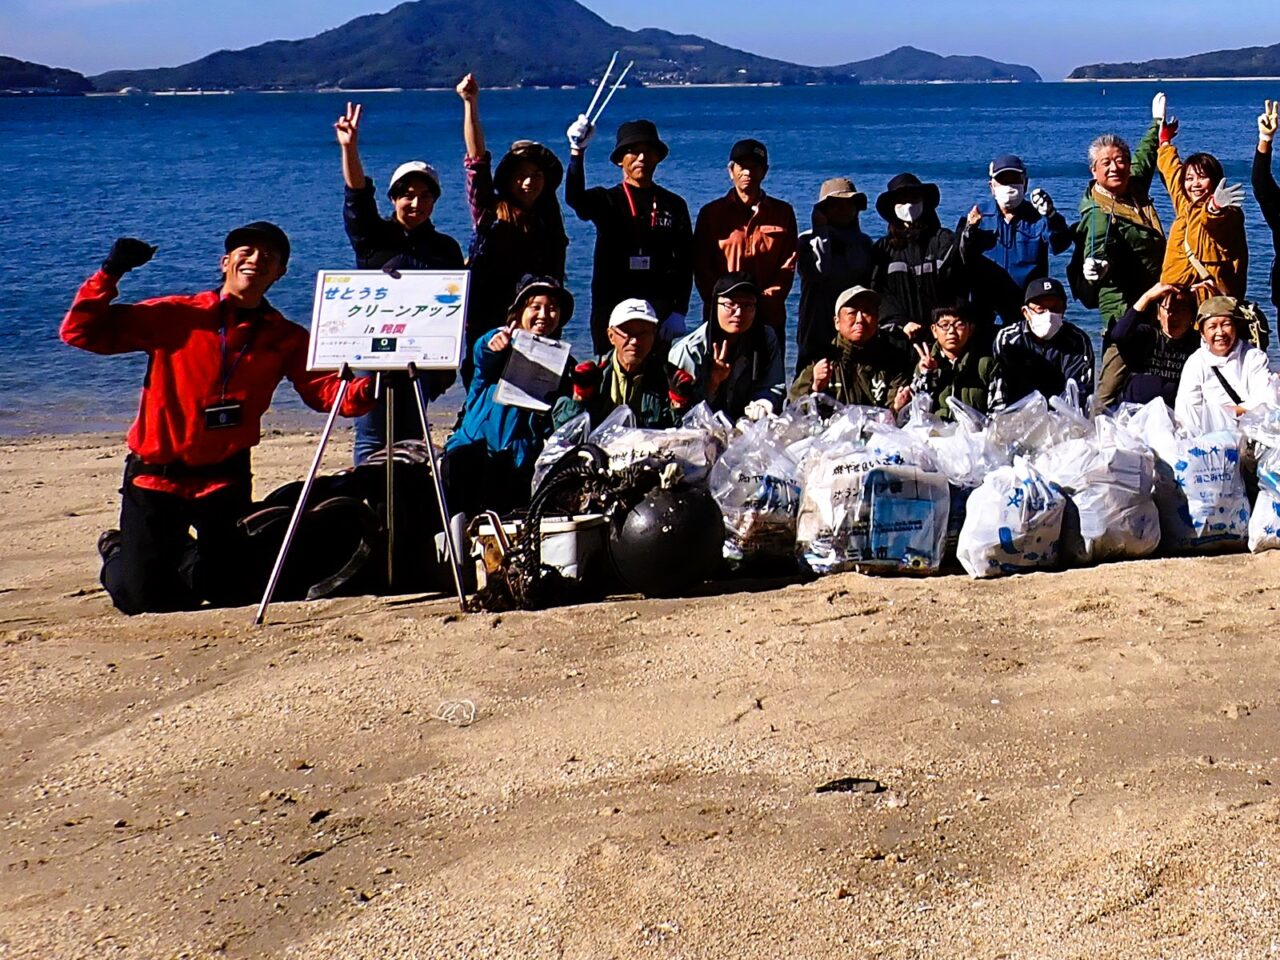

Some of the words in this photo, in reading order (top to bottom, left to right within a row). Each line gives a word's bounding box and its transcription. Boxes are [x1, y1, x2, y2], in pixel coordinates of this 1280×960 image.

[1043, 281, 1052, 290] B
[325, 287, 388, 300] せとうち
[348, 304, 461, 317] クリーンアップ
[364, 324, 375, 334] in
